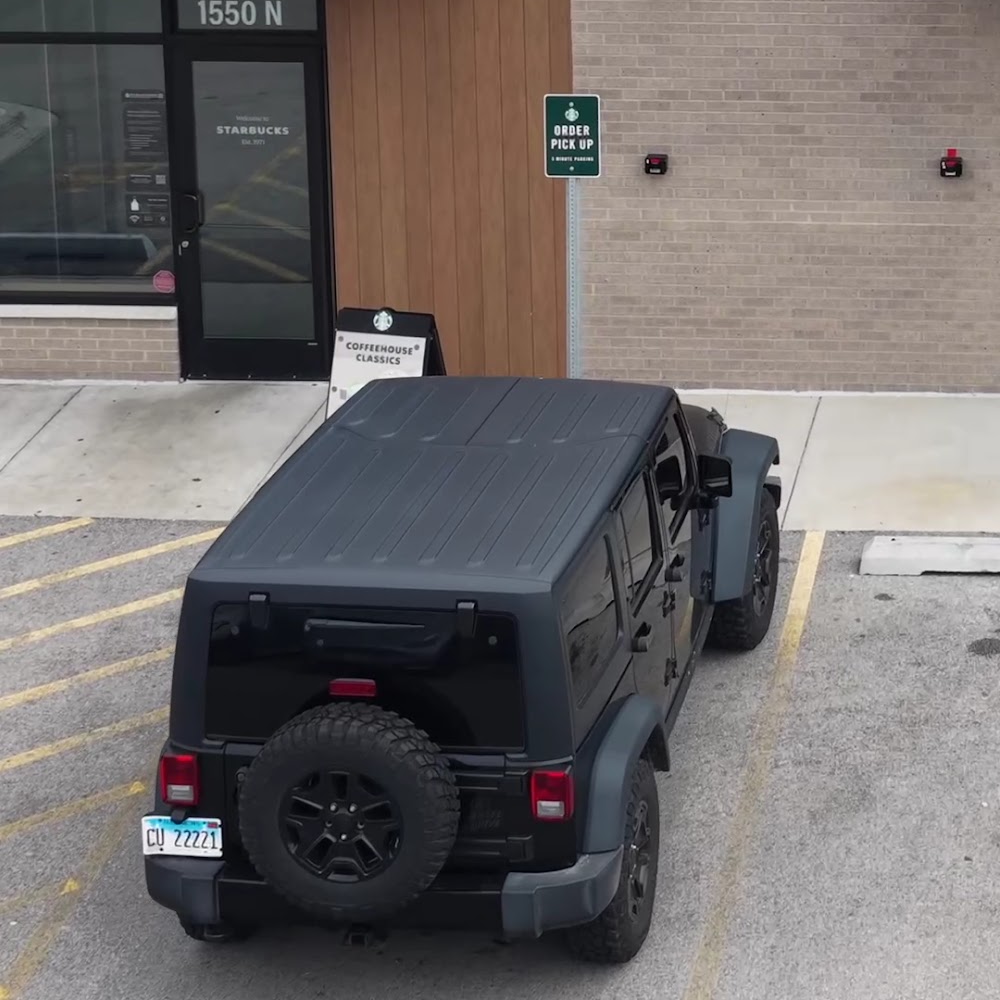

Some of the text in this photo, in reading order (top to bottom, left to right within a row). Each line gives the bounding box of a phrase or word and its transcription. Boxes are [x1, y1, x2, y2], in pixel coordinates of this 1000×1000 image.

[197, 0, 283, 26] 1550 N
[216, 125, 290, 136] STARBUCKS
[553, 124, 590, 136] ORDER
[551, 138, 594, 150] PICK UP
[345, 341, 414, 356] COFFEEHOUSE
[355, 353, 401, 365] CLASSICS
[147, 828, 219, 850] CU 22221
